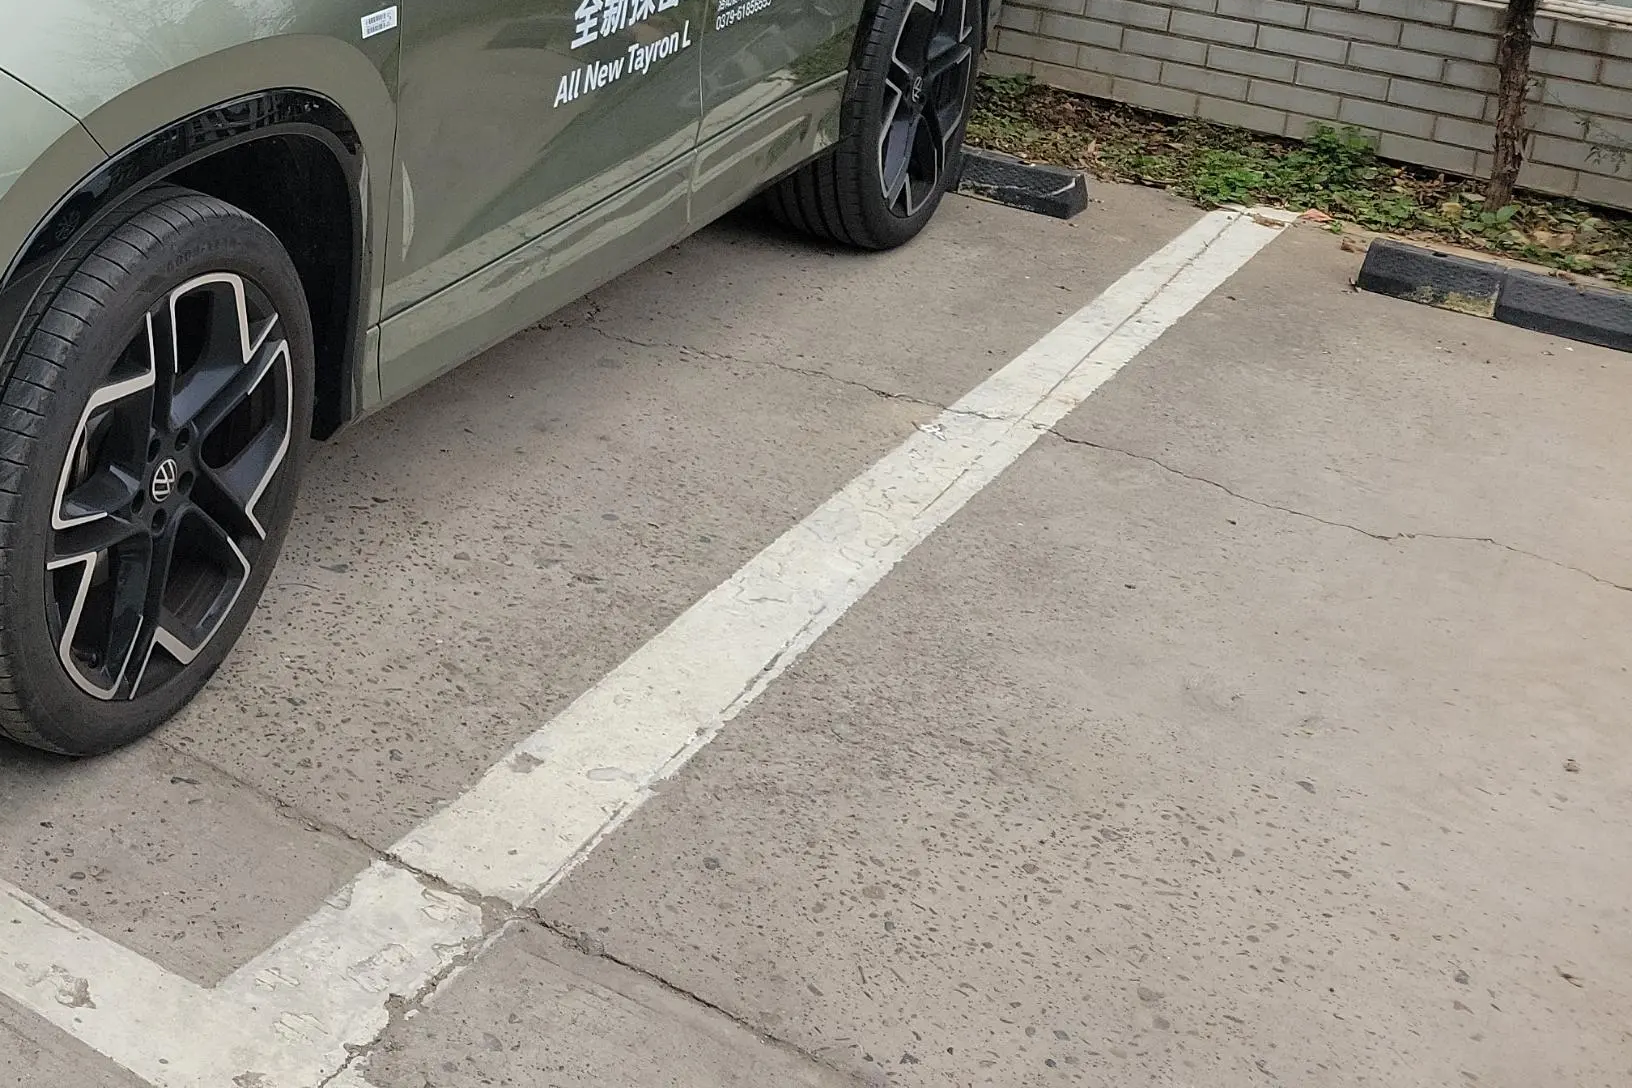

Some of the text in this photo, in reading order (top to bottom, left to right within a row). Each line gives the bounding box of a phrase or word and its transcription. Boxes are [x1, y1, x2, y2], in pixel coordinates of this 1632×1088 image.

[553, 19, 692, 108] All New Tayron L
